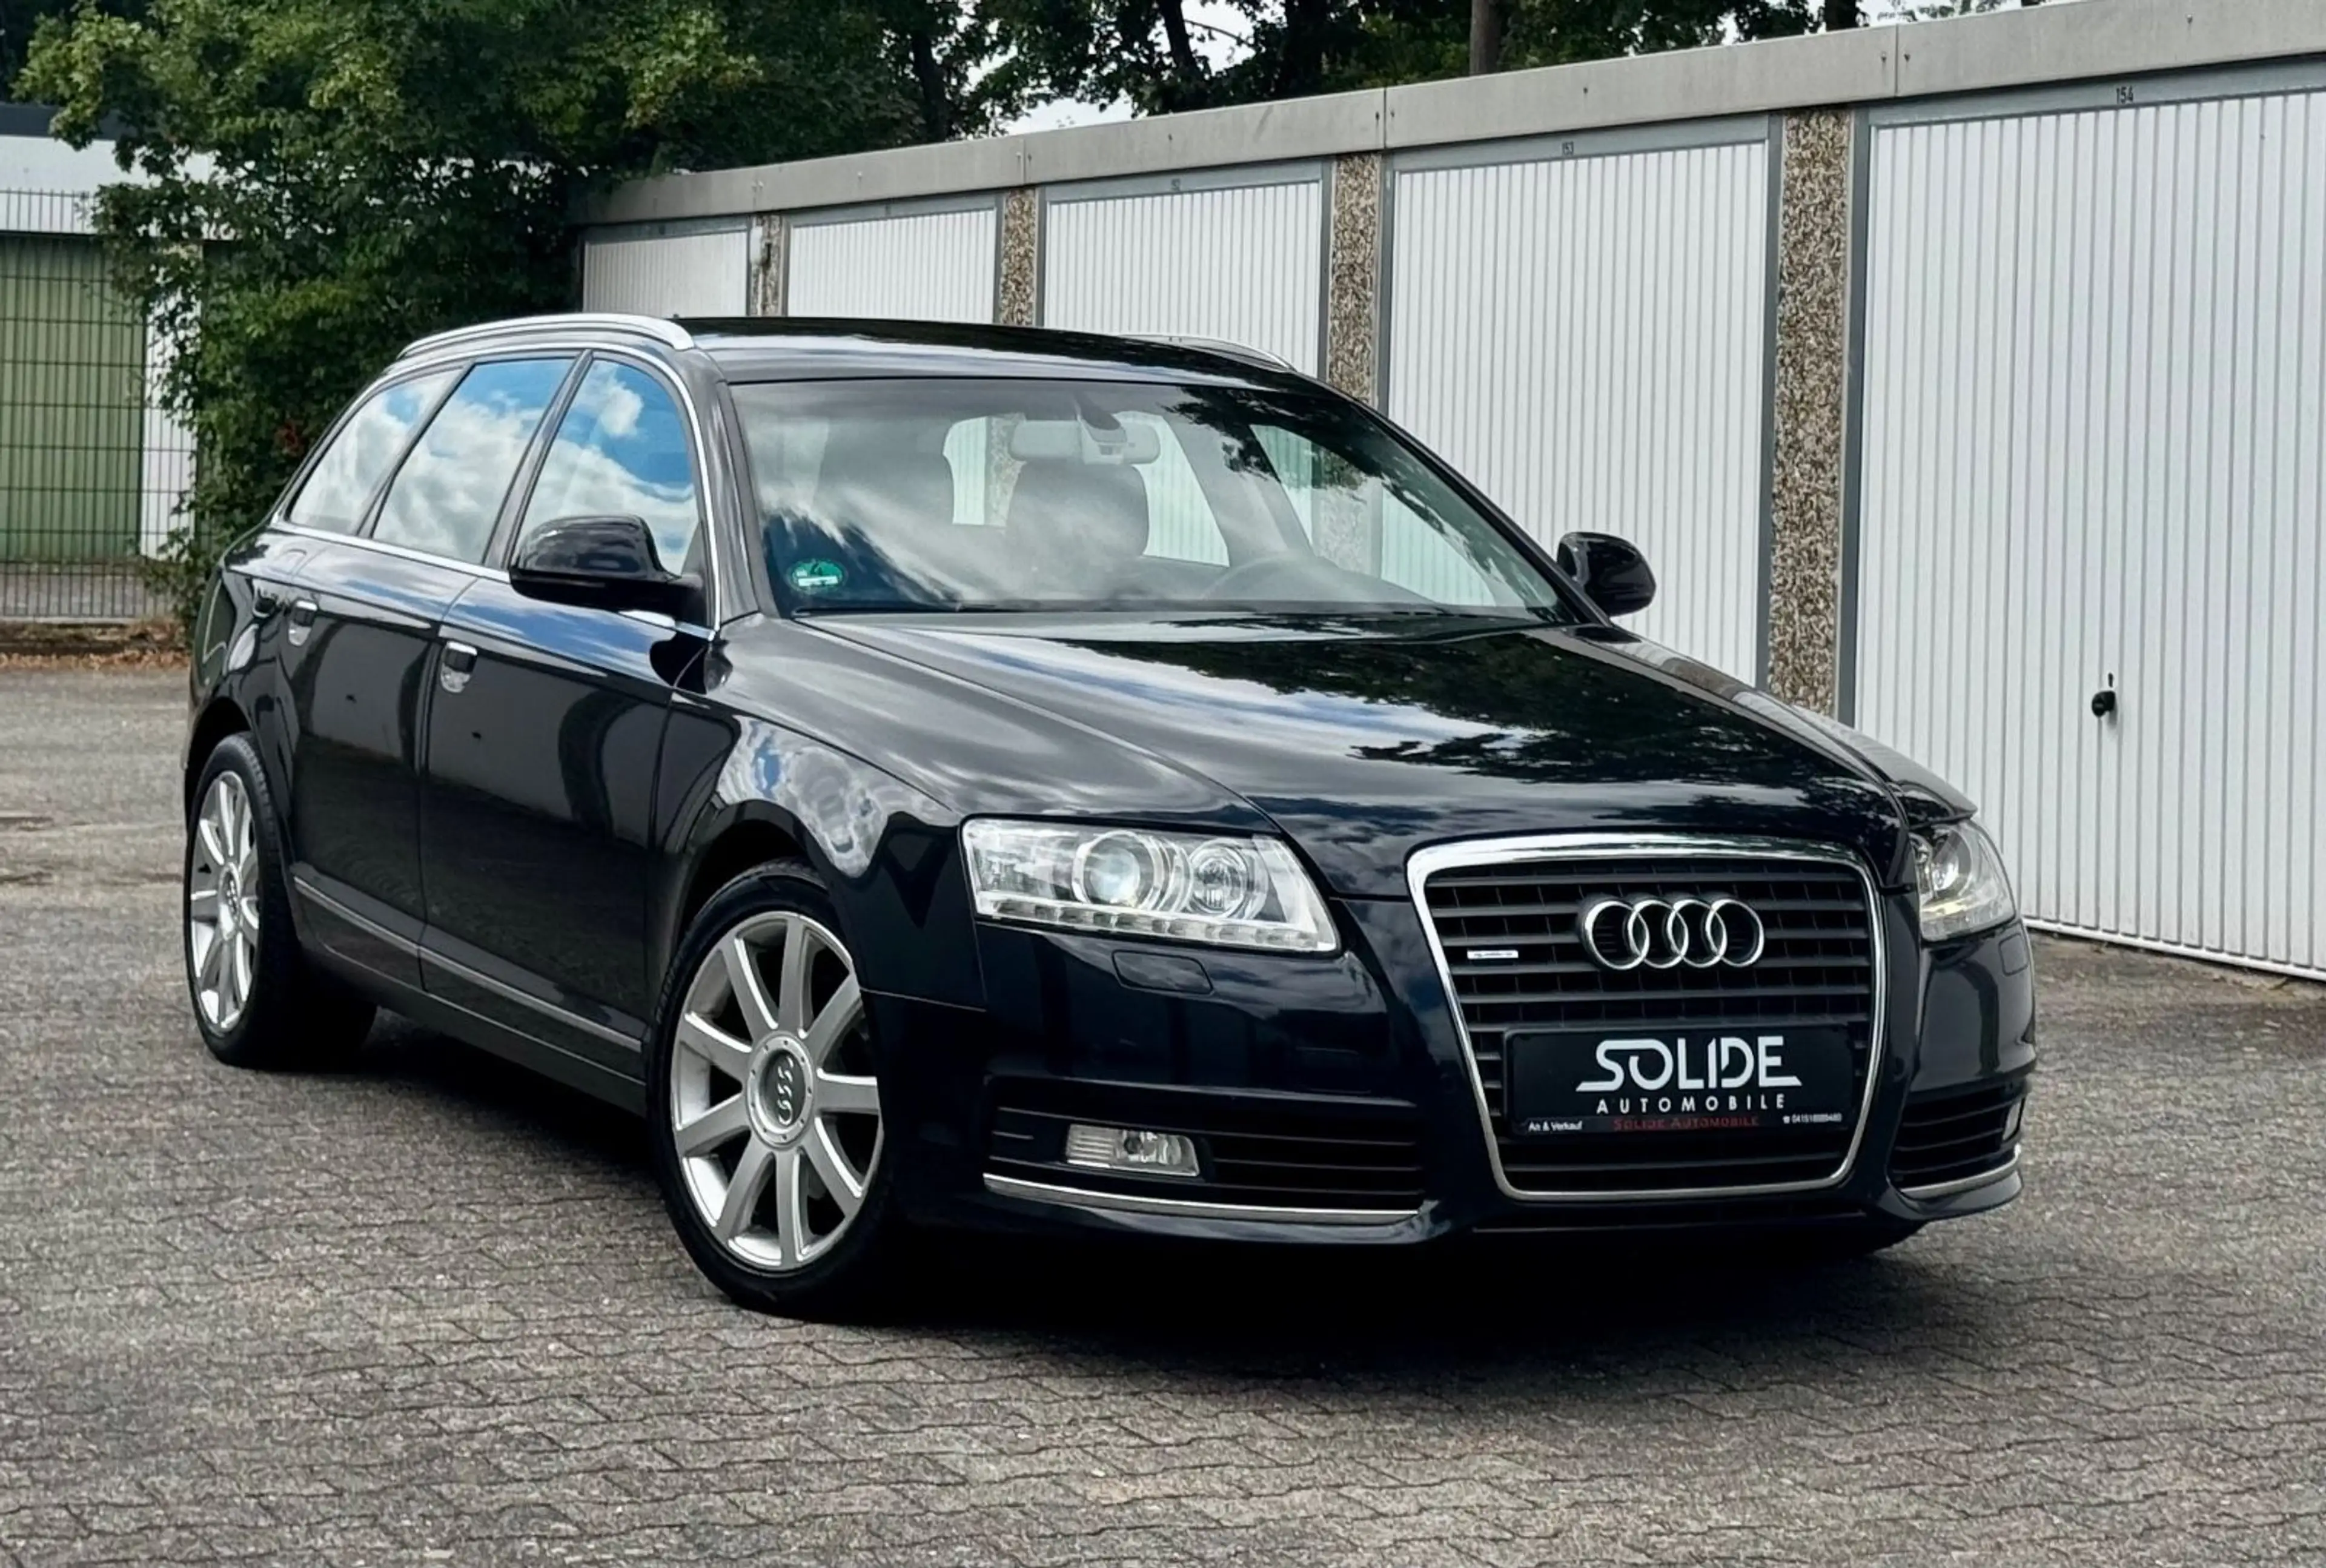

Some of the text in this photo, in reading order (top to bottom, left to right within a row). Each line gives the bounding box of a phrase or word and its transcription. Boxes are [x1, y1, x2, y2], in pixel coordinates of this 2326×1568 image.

[2116, 85, 2133, 104] 154
[1576, 1036, 1802, 1091] SOLIDE
[1596, 1093, 1785, 1114] AUTOMOBILE
